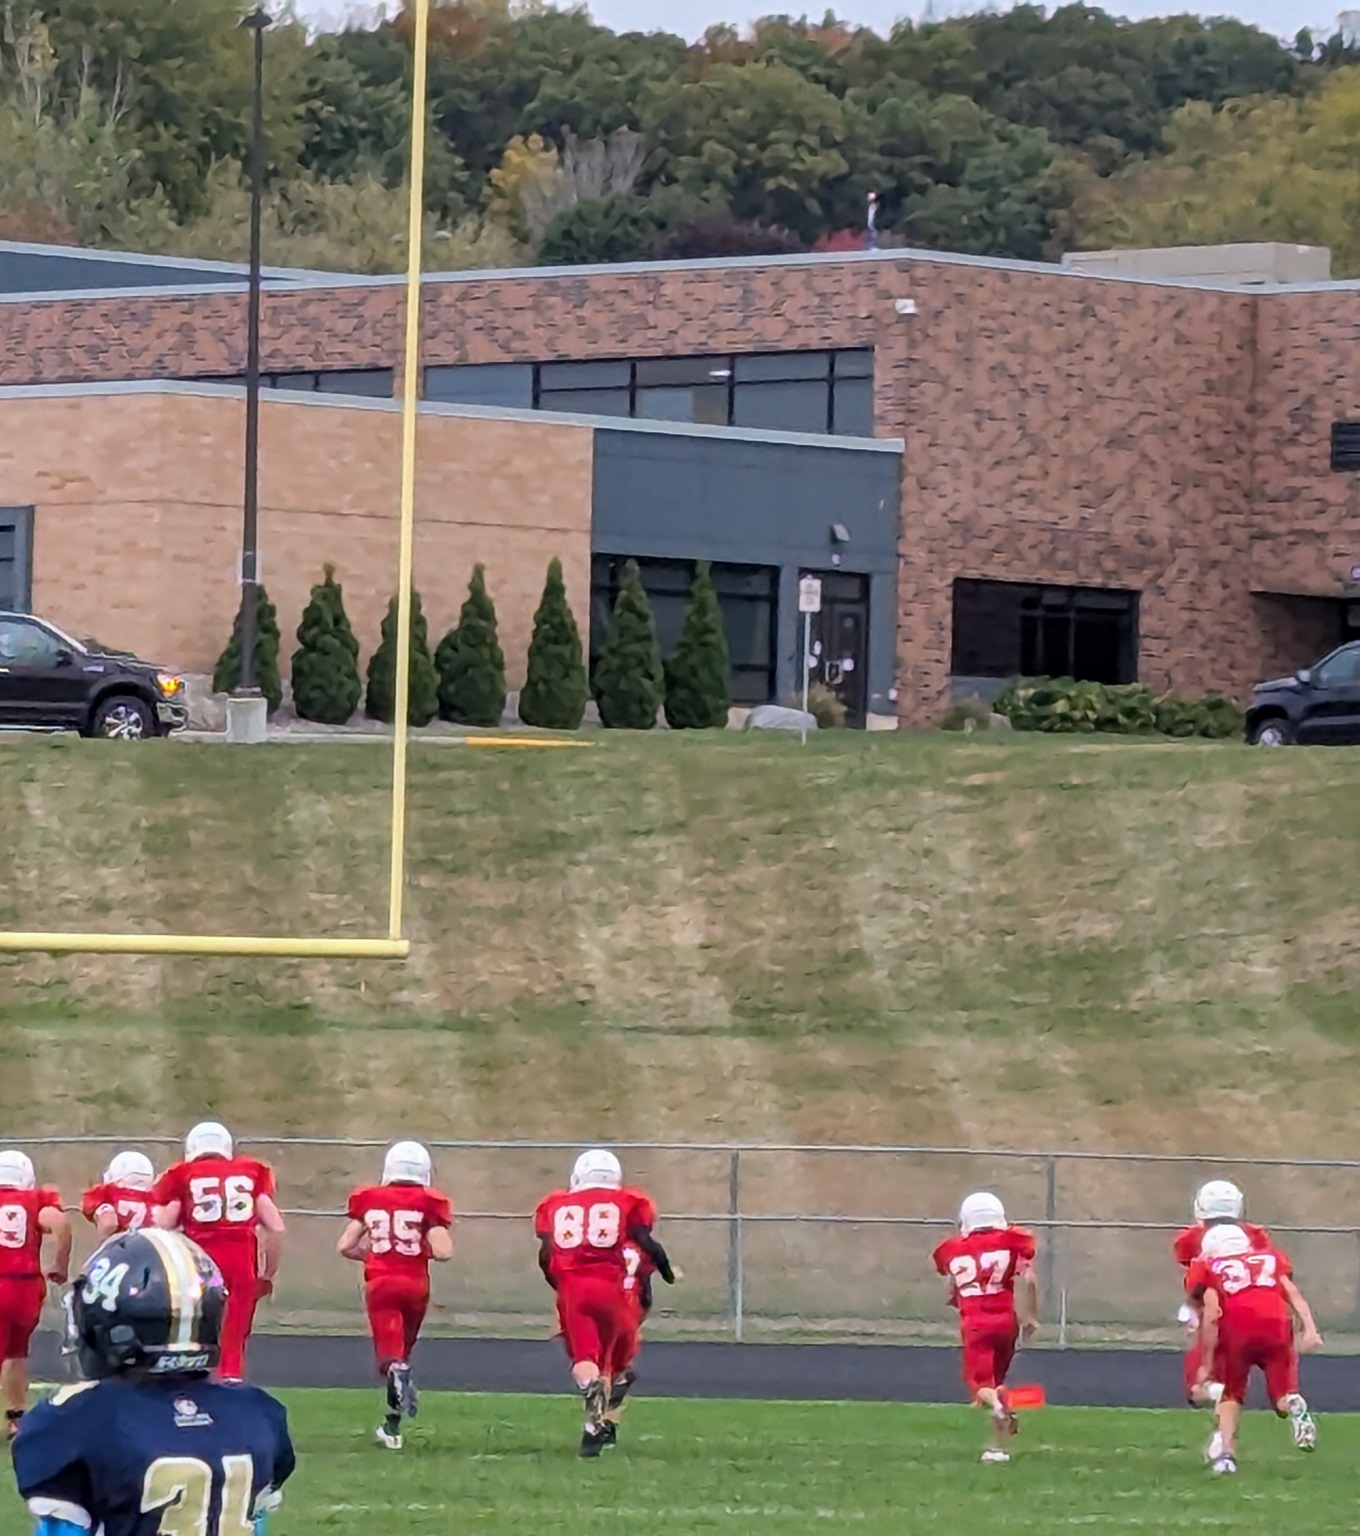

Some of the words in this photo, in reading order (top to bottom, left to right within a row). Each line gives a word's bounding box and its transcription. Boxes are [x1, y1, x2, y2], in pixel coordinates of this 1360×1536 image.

[189, 1175, 255, 1223] 56
[554, 1202, 622, 1249] 88
[948, 1249, 1012, 1298] 27
